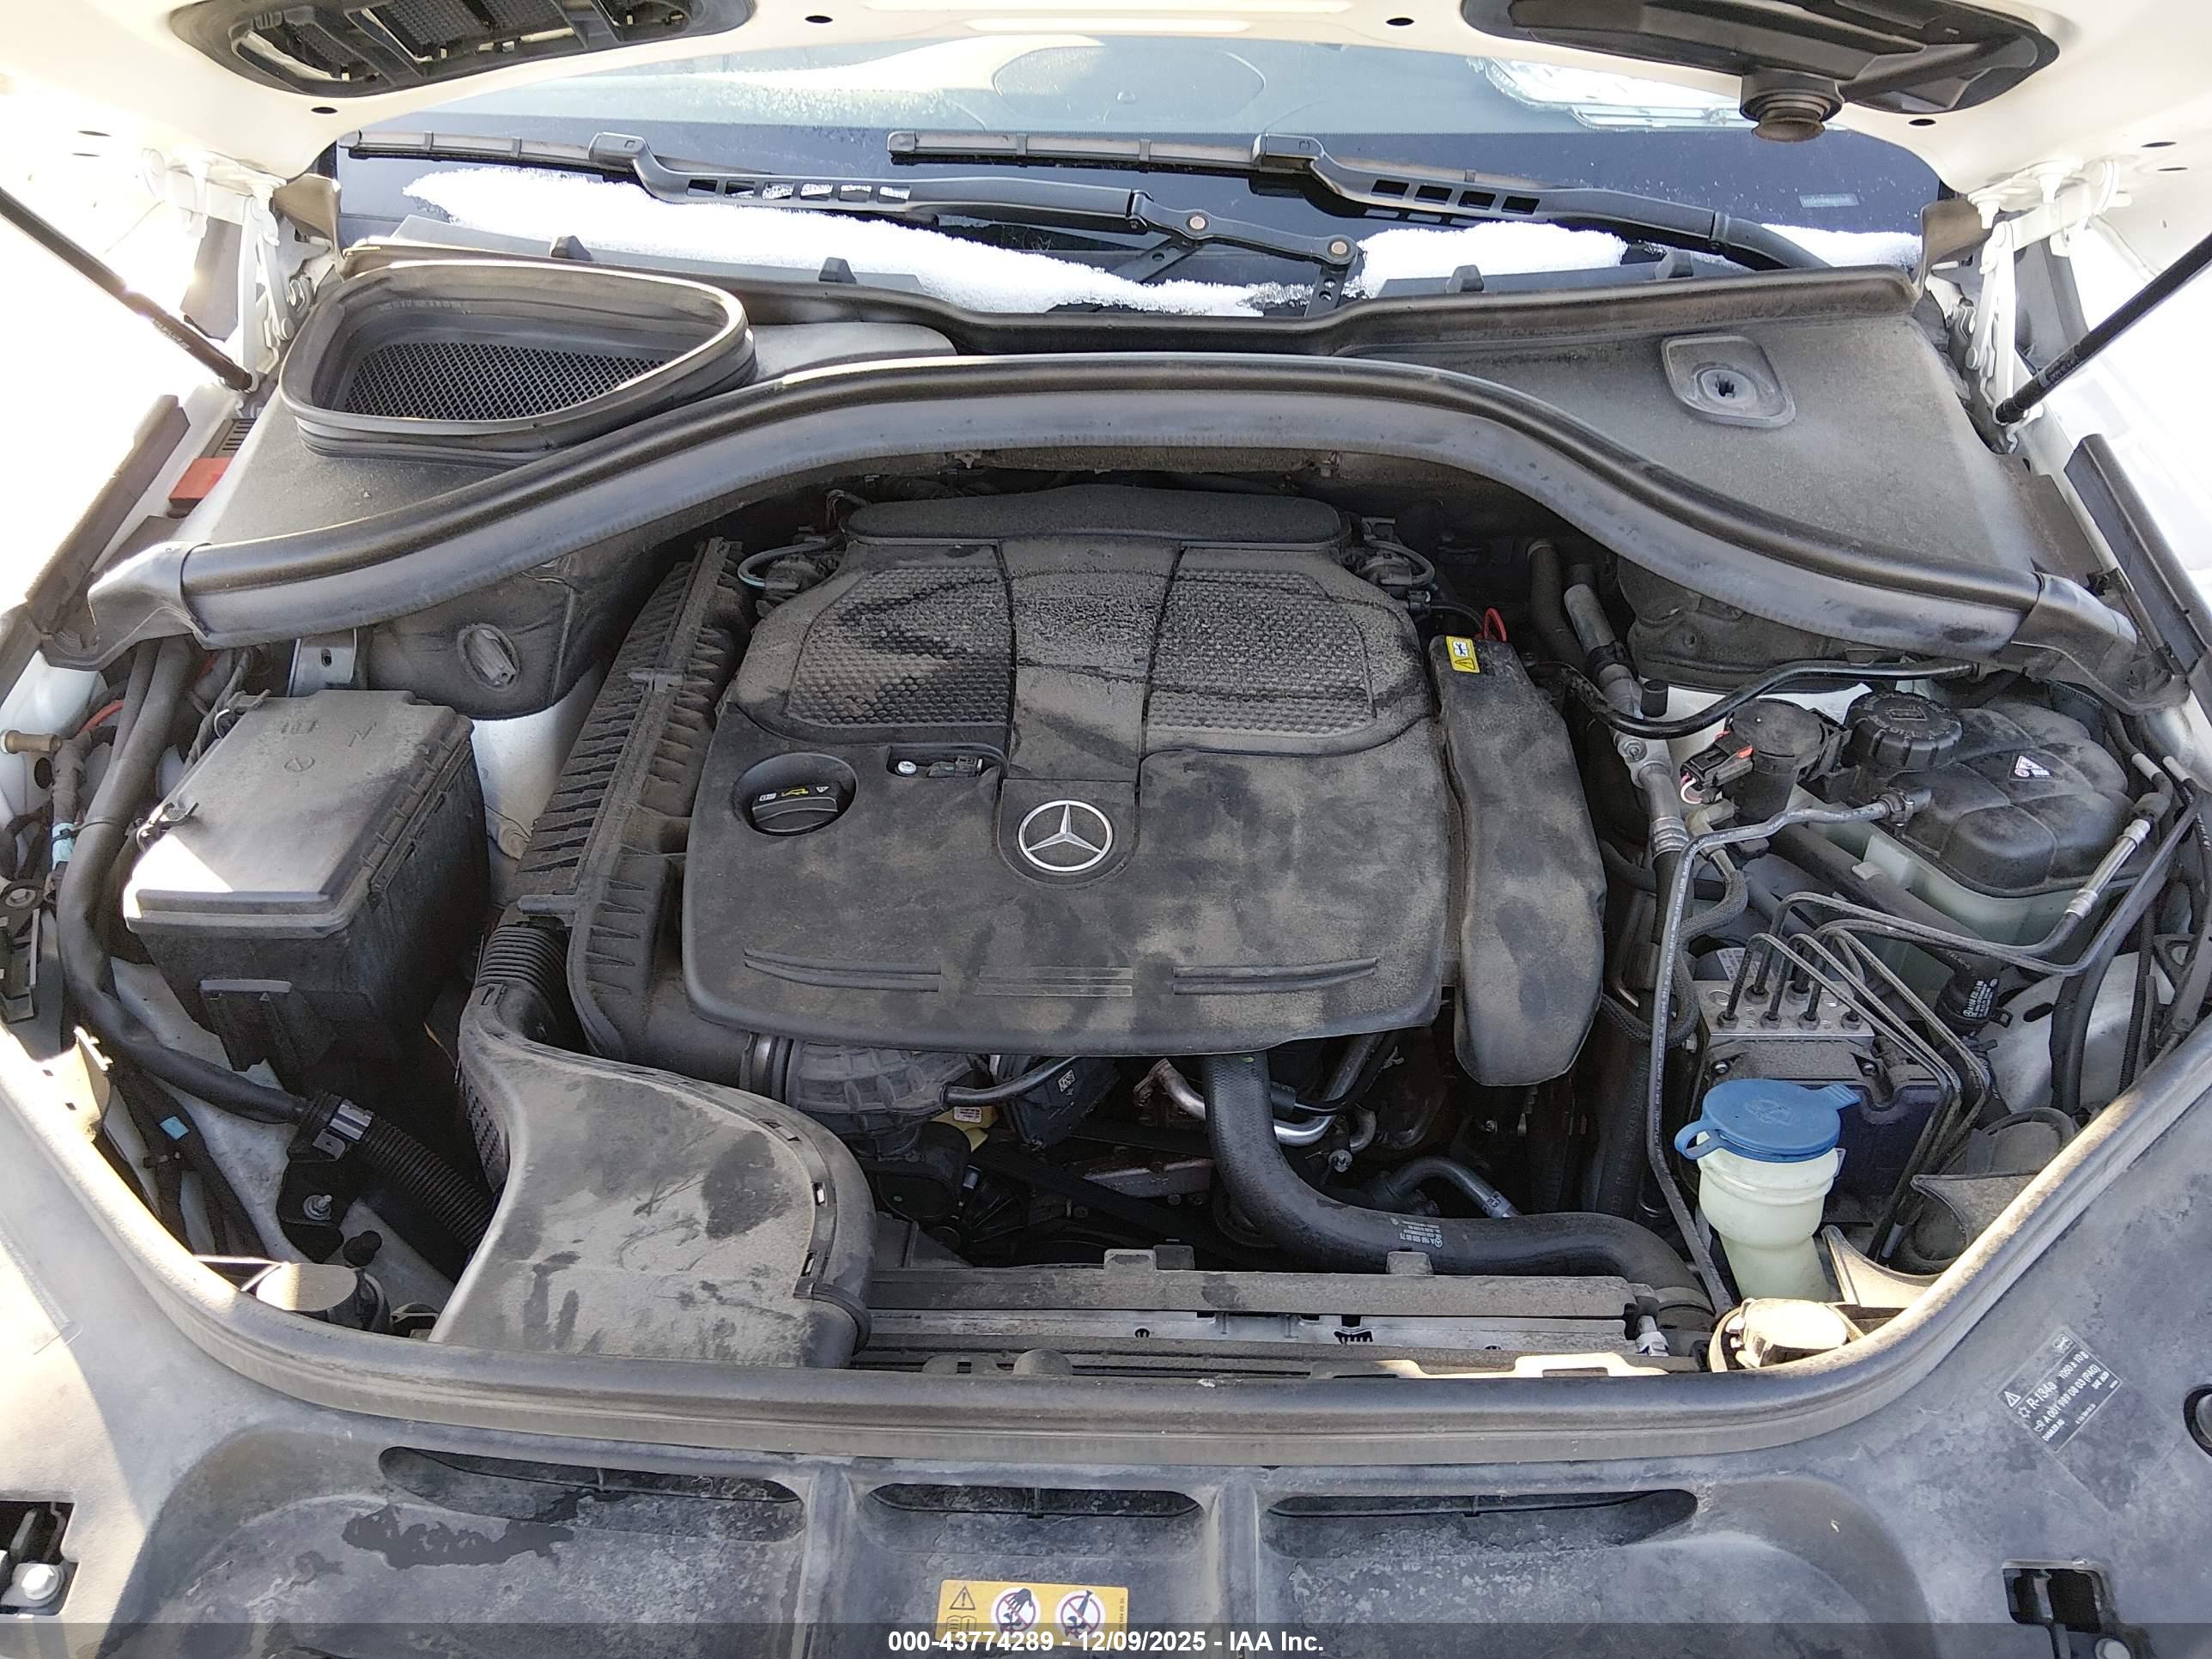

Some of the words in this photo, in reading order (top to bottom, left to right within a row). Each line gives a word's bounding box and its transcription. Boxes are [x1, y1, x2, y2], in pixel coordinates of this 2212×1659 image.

[2026, 1382, 2057, 1409] R-134a
[2058, 1365, 2074, 1379] 1050
[2073, 1353, 2084, 1363] 10
[2042, 1415, 2051, 1424] A
[2047, 1405, 2061, 1418] 001
[2057, 1394, 2071, 1407] 989
[2074, 1378, 2087, 1389] 03
[2081, 1364, 2101, 1382] (PAG)
